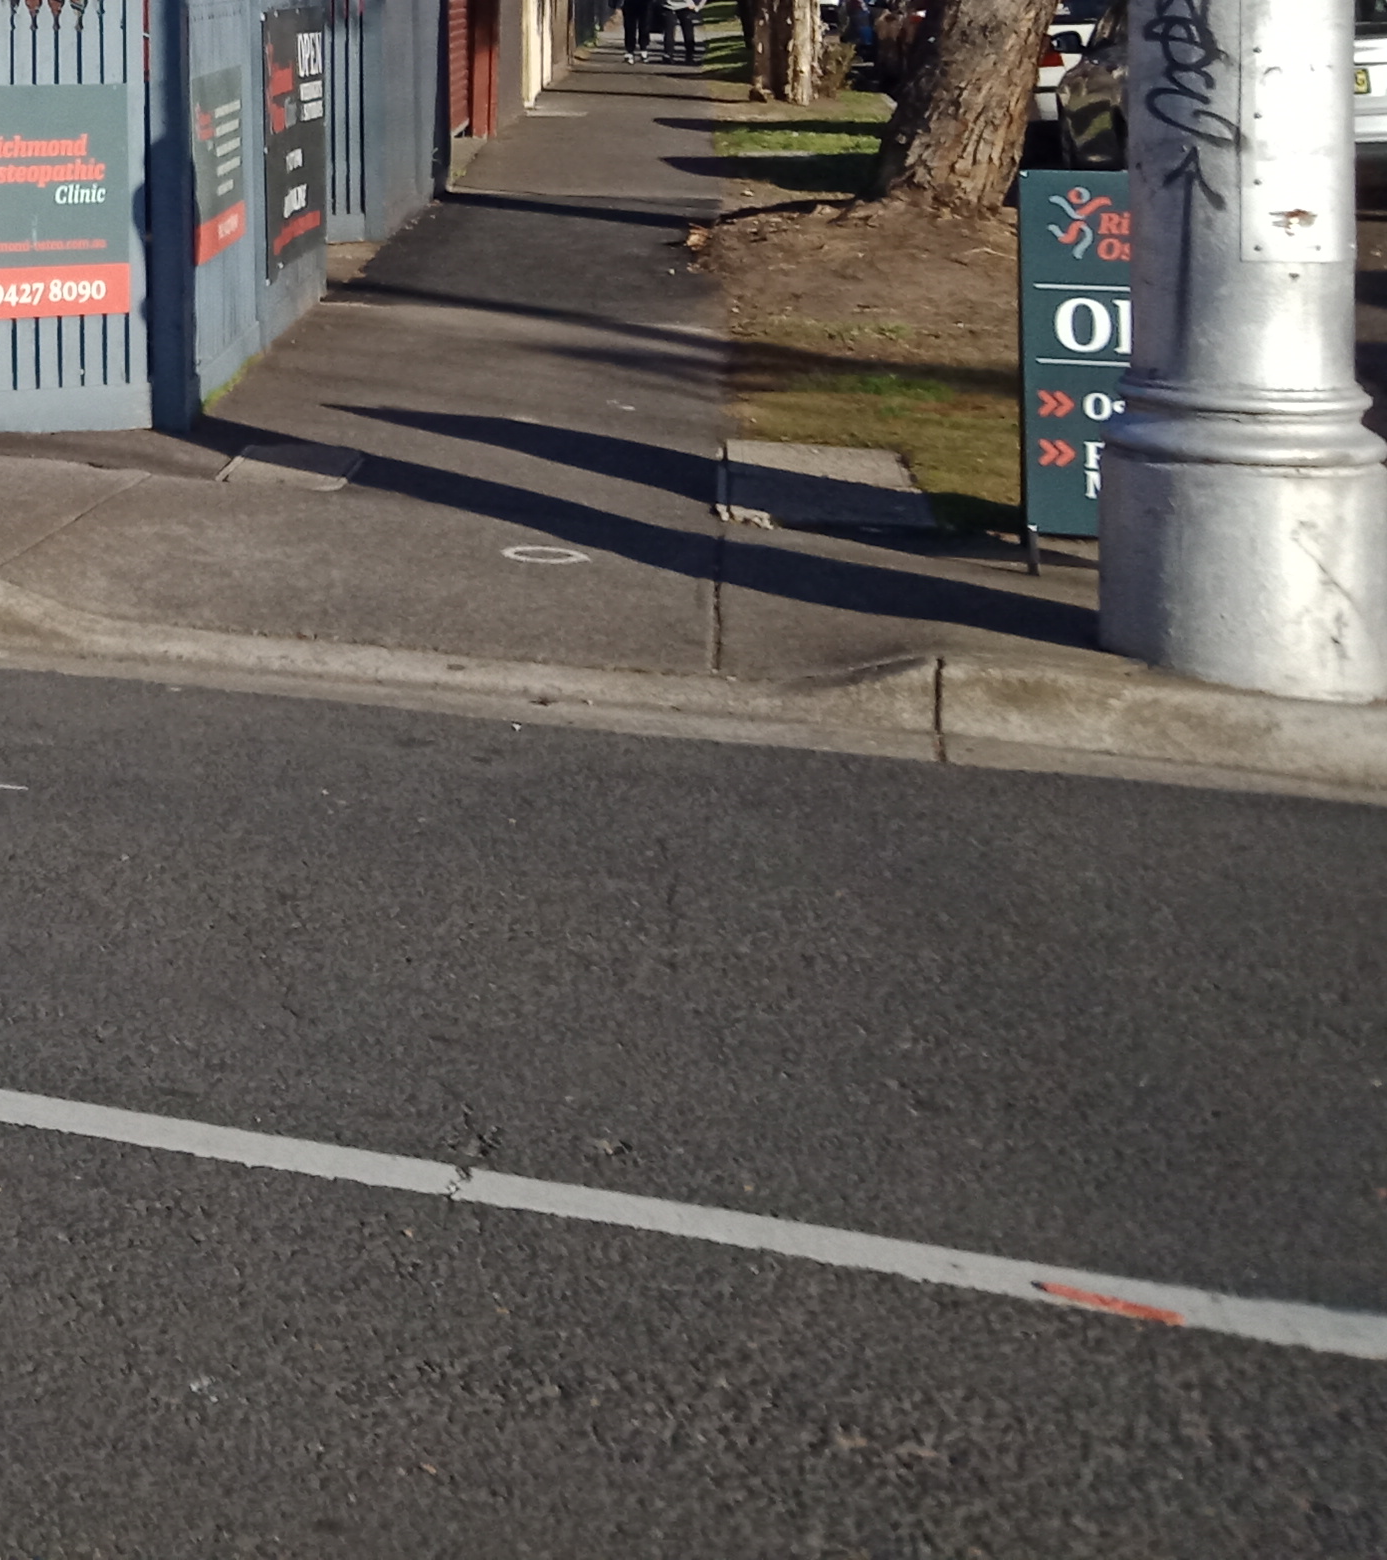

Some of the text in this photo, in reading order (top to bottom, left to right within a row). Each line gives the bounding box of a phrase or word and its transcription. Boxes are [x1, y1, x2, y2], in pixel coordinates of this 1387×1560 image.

[297, 31, 323, 77] OPEN
[55, 183, 106, 205] Clinic
[49, 279, 107, 303] 8090
